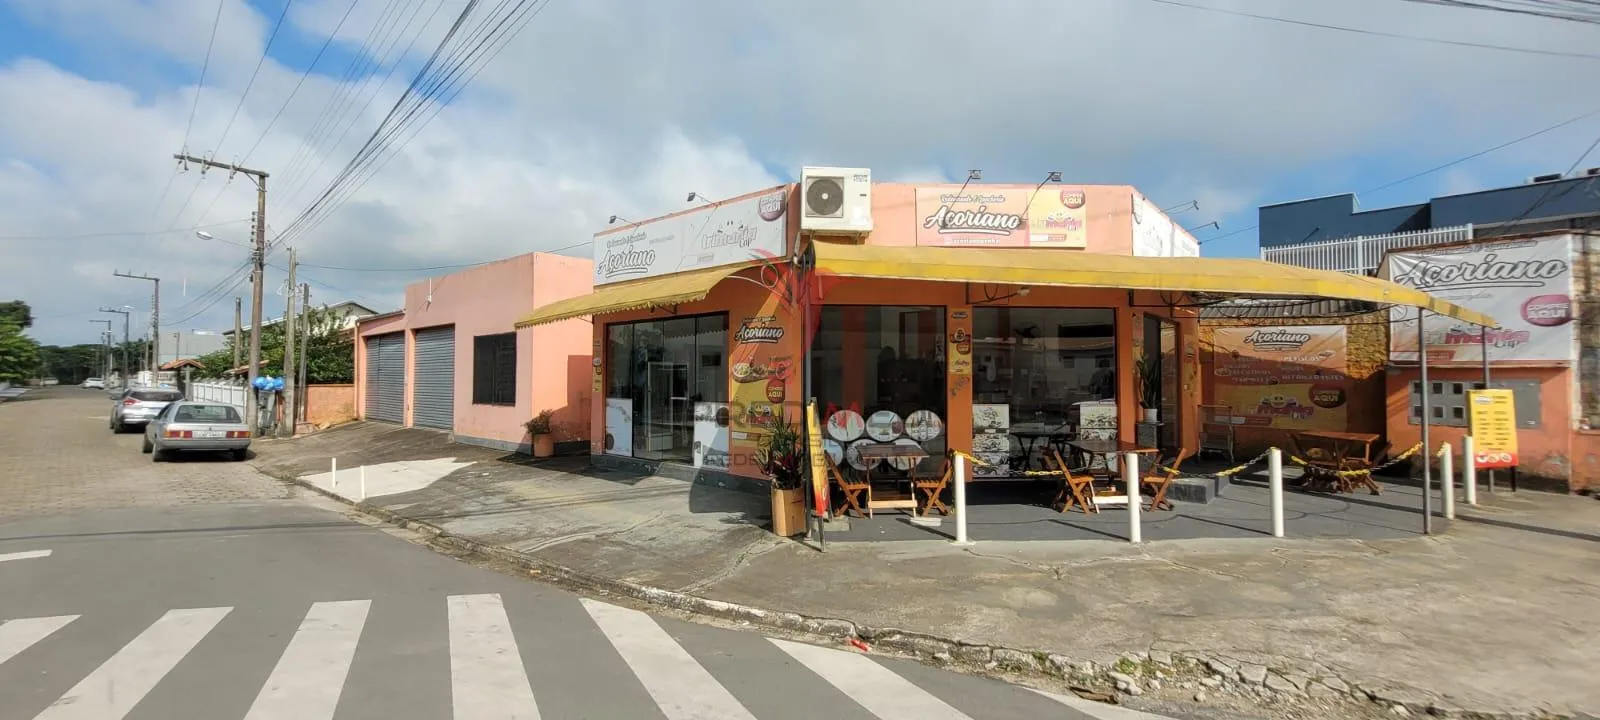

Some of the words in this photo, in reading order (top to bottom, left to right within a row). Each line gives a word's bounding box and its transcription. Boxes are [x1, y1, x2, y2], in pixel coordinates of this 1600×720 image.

[597, 245, 656, 275] Açoriano
[1394, 254, 1568, 288] Açoriano
[735, 323, 784, 341] Açoriano
[1244, 329, 1311, 344] Açoriano
